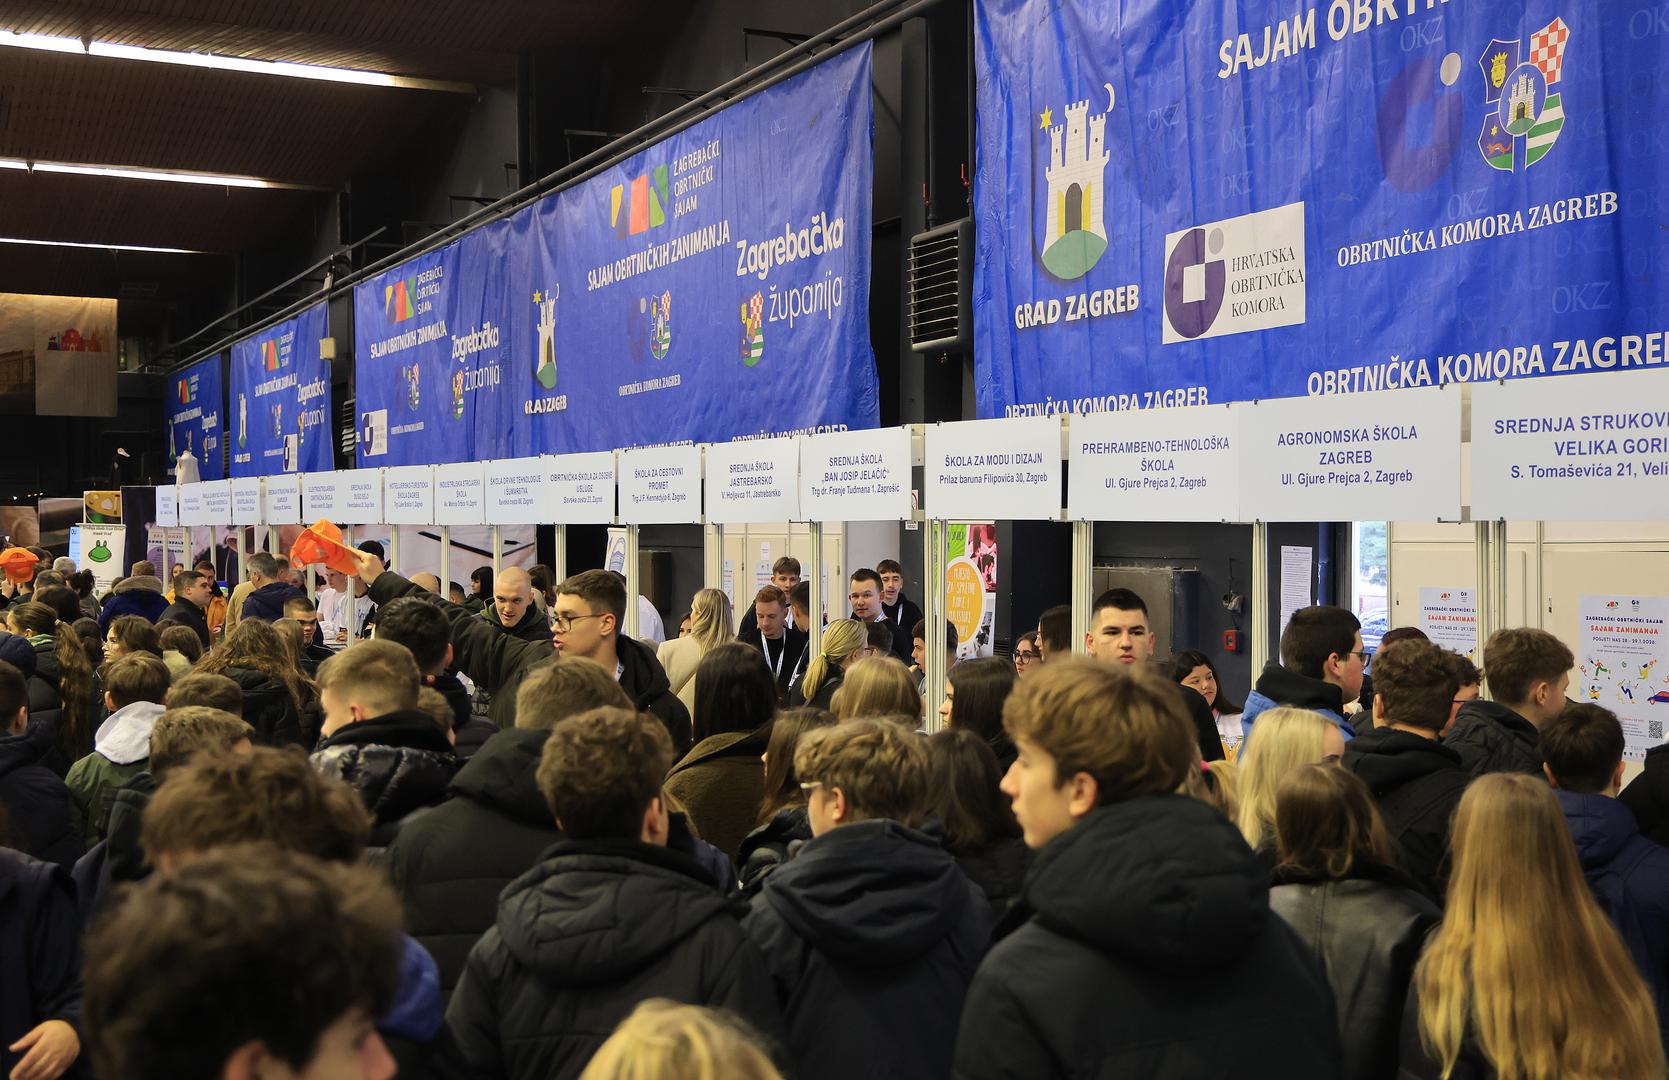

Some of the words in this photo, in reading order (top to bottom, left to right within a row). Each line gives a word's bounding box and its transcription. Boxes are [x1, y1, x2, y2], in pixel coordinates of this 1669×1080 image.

[1218, 8, 1315, 79] SAJAM
[673, 140, 720, 176] ZAGREBAČKI
[674, 165, 713, 197] OBRTNIČKI
[674, 195, 697, 219] SAJAM
[1337, 229, 1437, 267] OBRTNIČKA
[1440, 210, 1526, 248] KOMORA
[1527, 191, 1618, 230] ZAGREB
[736, 211, 844, 280] Zagrebačka
[588, 264, 613, 291] SAJAM
[614, 242, 670, 282] OBRTNIČKIH
[671, 220, 730, 263] ZANIMANJA
[1232, 246, 1295, 272] HRVATSKA
[1231, 267, 1304, 294] OBRTNIČKA
[769, 269, 842, 329] županija
[1014, 299, 1060, 329] GRAD
[1065, 284, 1139, 321] ZAGREB
[1232, 296, 1285, 317] KOMORA
[451, 321, 499, 362] Zagrebačka
[1307, 355, 1431, 396] OBRTNIČKA
[1438, 343, 1545, 384] KOMORA
[1494, 416, 1575, 434] SREDNJA
[1580, 411, 1669, 431] STRUKOV
[1082, 435, 1230, 454] PREHRAMBENO-TEHNOLOŠKA
[1277, 428, 1370, 446] AGRONOMSKA
[1372, 425, 1417, 441] ŠKOLA
[1554, 439, 1618, 456] VELIKA
[829, 456, 860, 466] SREDNJA
[860, 453, 883, 465] ŠKOLA
[944, 454, 972, 466] ŠKOLA
[974, 455, 985, 466] ZA
[986, 454, 1010, 465] MODU
[1011, 454, 1014, 464] I
[1015, 453, 1043, 464] DIZAJN
[1140, 457, 1175, 471] ŠKOLA
[1319, 450, 1373, 465] ZAGREB
[634, 468, 650, 478] ŠKOLA
[651, 468, 658, 477] ZA
[658, 467, 684, 477] CESTOVNI
[729, 463, 754, 473] SREDNJA
[755, 461, 774, 472] ŠKOLA
[840, 470, 858, 481] JOSIP
[1511, 465, 1523, 478] S.
[1529, 463, 1611, 478] Tomaševića
[1616, 462, 1637, 478] 21,
[550, 472, 577, 482] OBRTNIČKA
[578, 472, 592, 481] ŠKOLA
[648, 481, 668, 490] PROMET
[730, 475, 773, 487] JASTREBARSKO
[939, 474, 958, 484] Prilaz
[959, 474, 982, 483] baruna
[983, 472, 1014, 485] Filipovića
[1026, 472, 1048, 484] Zagreb
[1105, 477, 1116, 488] Ul.
[1118, 477, 1141, 491] Gjure
[1143, 477, 1168, 491] Prejca
[1170, 477, 1178, 489] 2,
[1179, 476, 1207, 491] Zagreb
[1281, 473, 1294, 485] Ul.
[1297, 472, 1325, 487] Gjure
[1328, 472, 1360, 487] Prejca
[1363, 470, 1373, 484] 2,
[1376, 469, 1413, 485] Zagreb
[672, 493, 686, 502] Zagreb
[811, 487, 820, 497] Trg
[829, 486, 845, 496] Franje
[847, 485, 870, 494] Tuđmana
[877, 482, 900, 494] Zaprešić
[1616, 626, 1659, 635] ZANIMANJA
